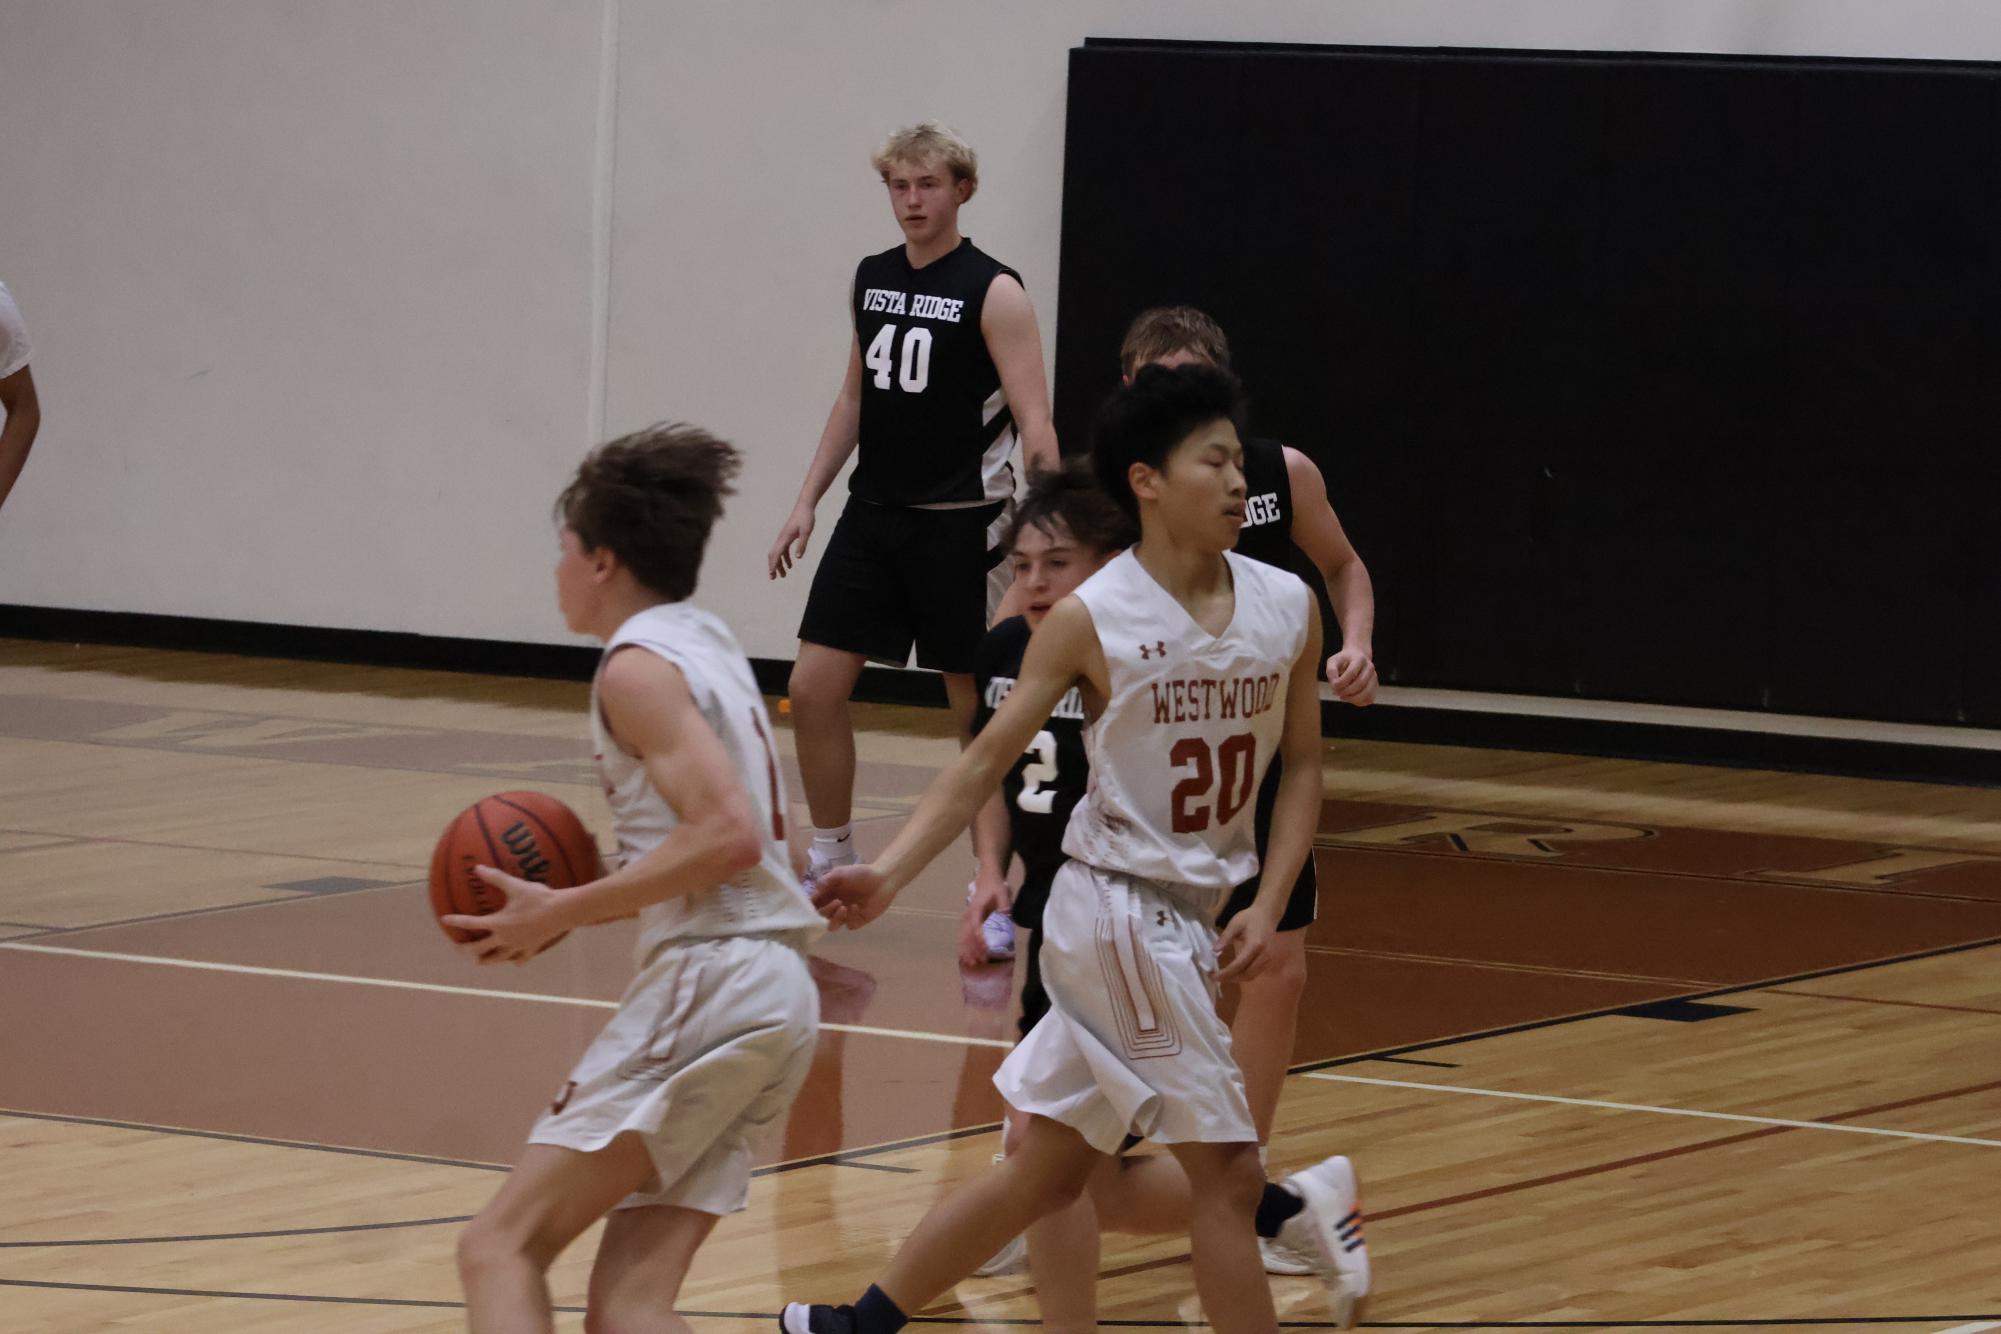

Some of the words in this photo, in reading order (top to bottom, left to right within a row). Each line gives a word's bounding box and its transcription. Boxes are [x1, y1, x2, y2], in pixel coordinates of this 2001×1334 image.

[863, 288, 906, 315] VISTA
[909, 293, 964, 323] RIDGE
[866, 323, 933, 393] 40
[1151, 672, 1280, 724] WESTWOOD
[1170, 732, 1256, 833] 20
